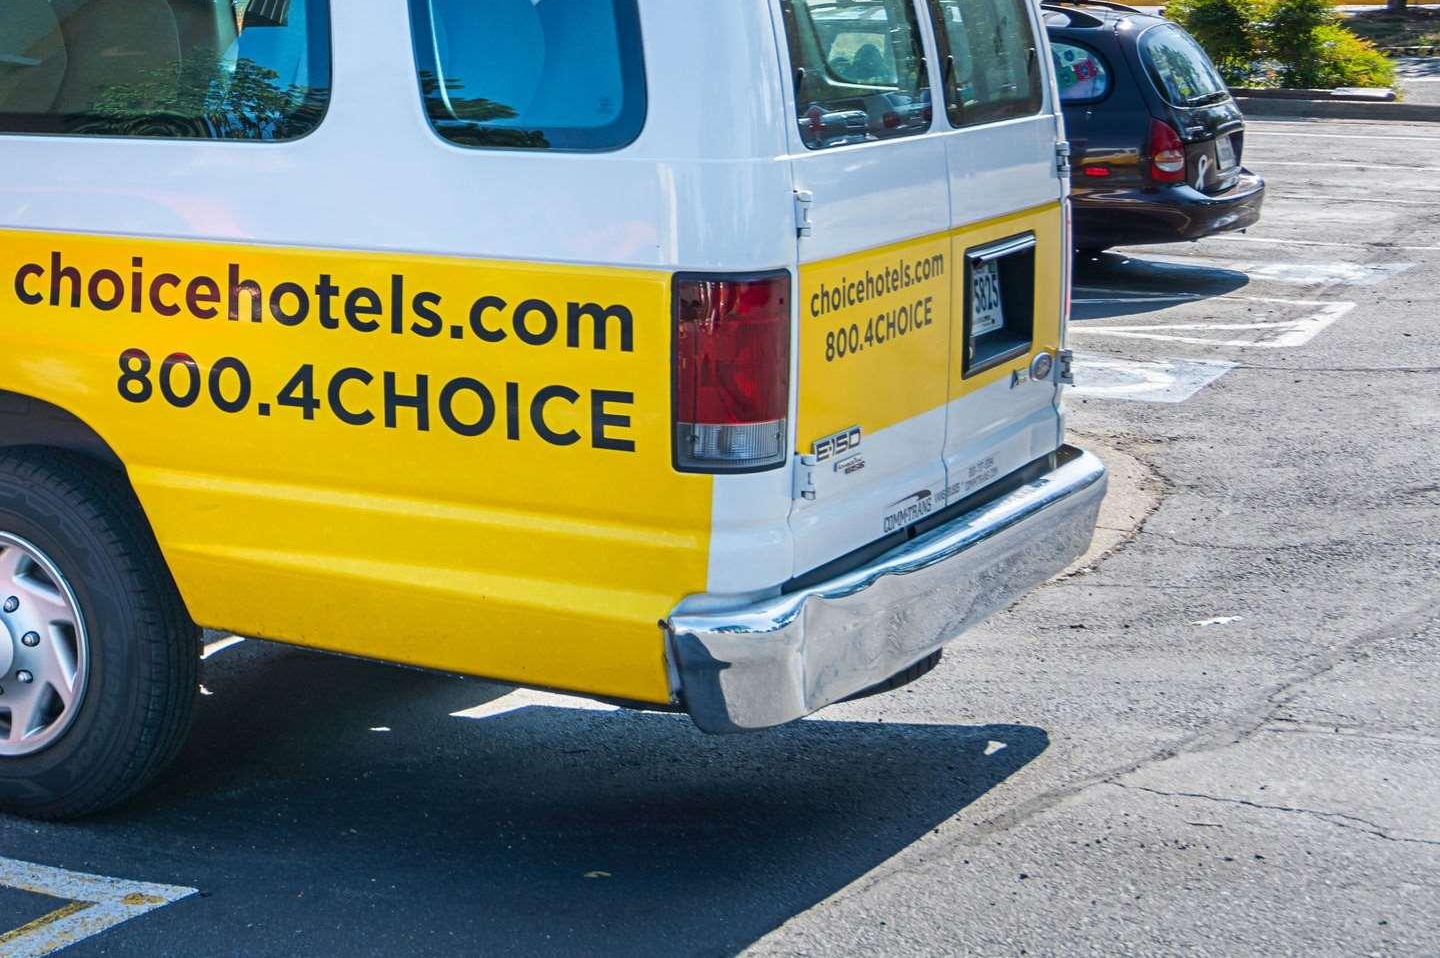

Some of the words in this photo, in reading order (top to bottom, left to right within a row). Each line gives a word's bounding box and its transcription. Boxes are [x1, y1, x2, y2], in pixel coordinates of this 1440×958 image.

[14, 251, 634, 352] choicehotels.com
[811, 253, 944, 318] choicehotels.com
[825, 296, 933, 362] 800.4CHOICE
[117, 347, 636, 452] 800.4CHOICE
